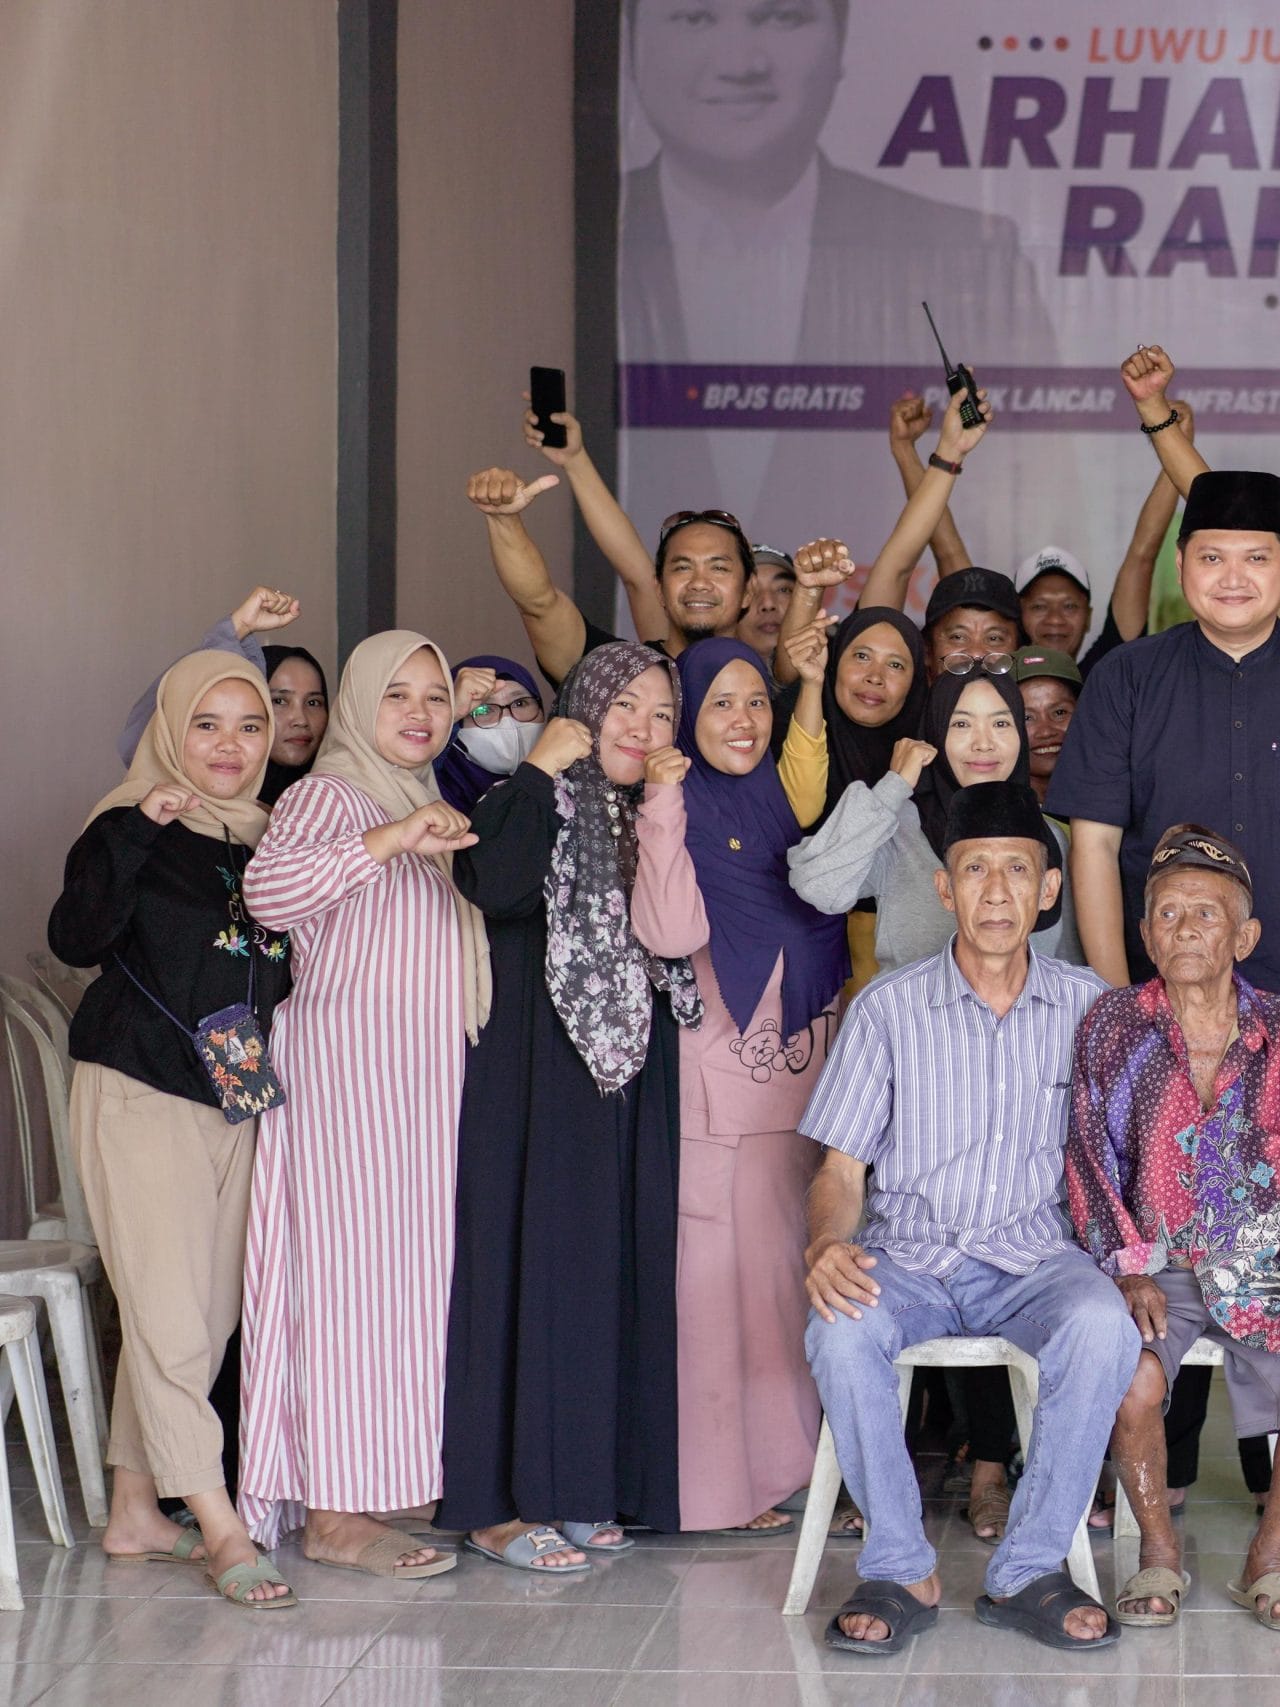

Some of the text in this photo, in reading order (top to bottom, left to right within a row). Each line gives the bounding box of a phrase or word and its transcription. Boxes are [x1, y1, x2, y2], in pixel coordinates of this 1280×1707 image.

[1087, 27, 1226, 65] LUWU
[703, 383, 865, 411] BPJS GRATIS
[1010, 386, 1117, 413] LANCAR
